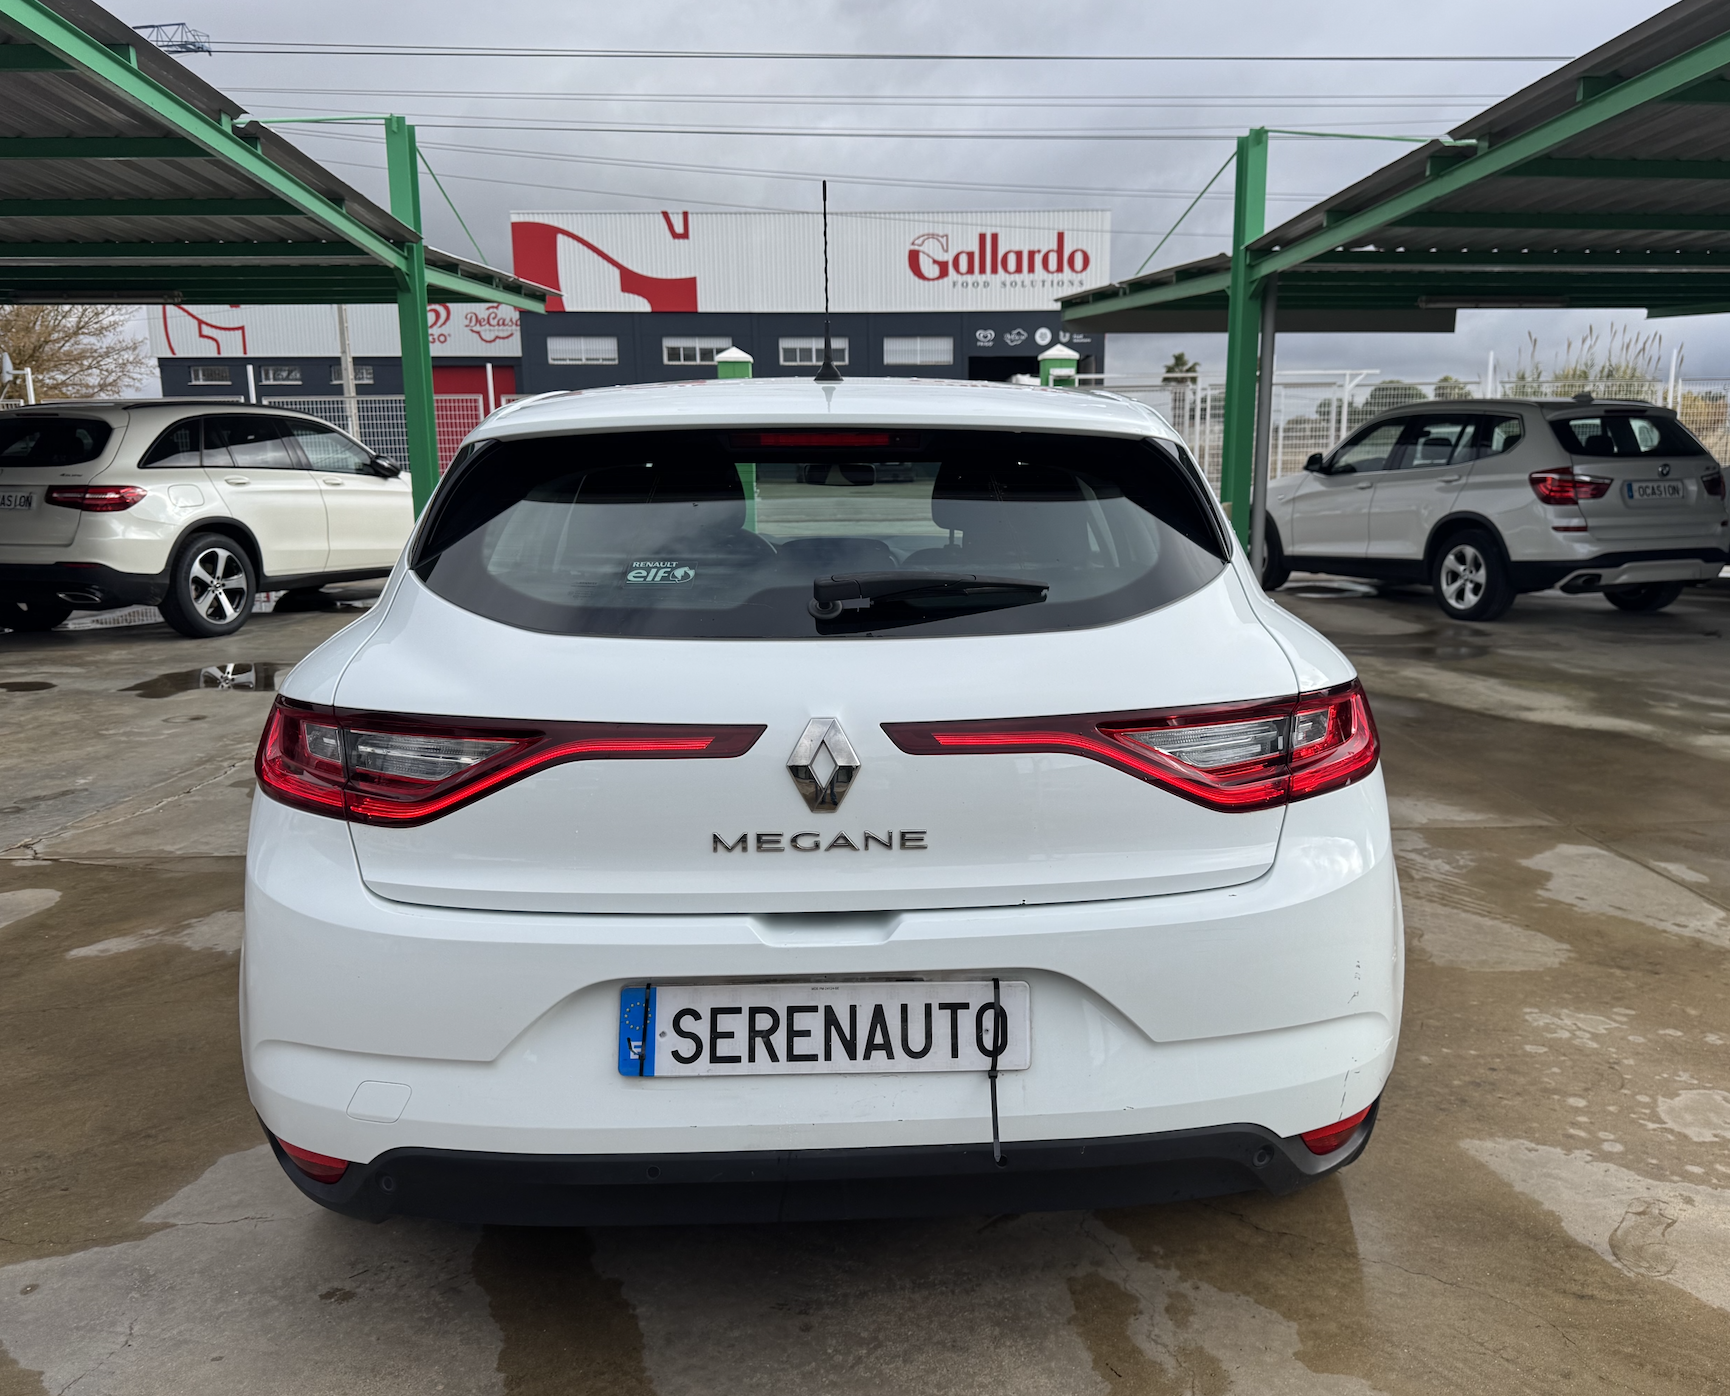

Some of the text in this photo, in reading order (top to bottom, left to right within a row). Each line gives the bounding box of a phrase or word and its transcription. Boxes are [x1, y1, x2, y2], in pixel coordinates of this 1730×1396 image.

[908, 231, 1090, 281] Gallardo
[952, 279, 1085, 289] FOOD SOLUTIONS
[1638, 484, 1680, 498] OCASION
[0, 494, 33, 508] ASION
[626, 568, 672, 582] elf
[712, 829, 928, 852] MEGANE
[671, 1002, 1008, 1064] SERENAUTO
